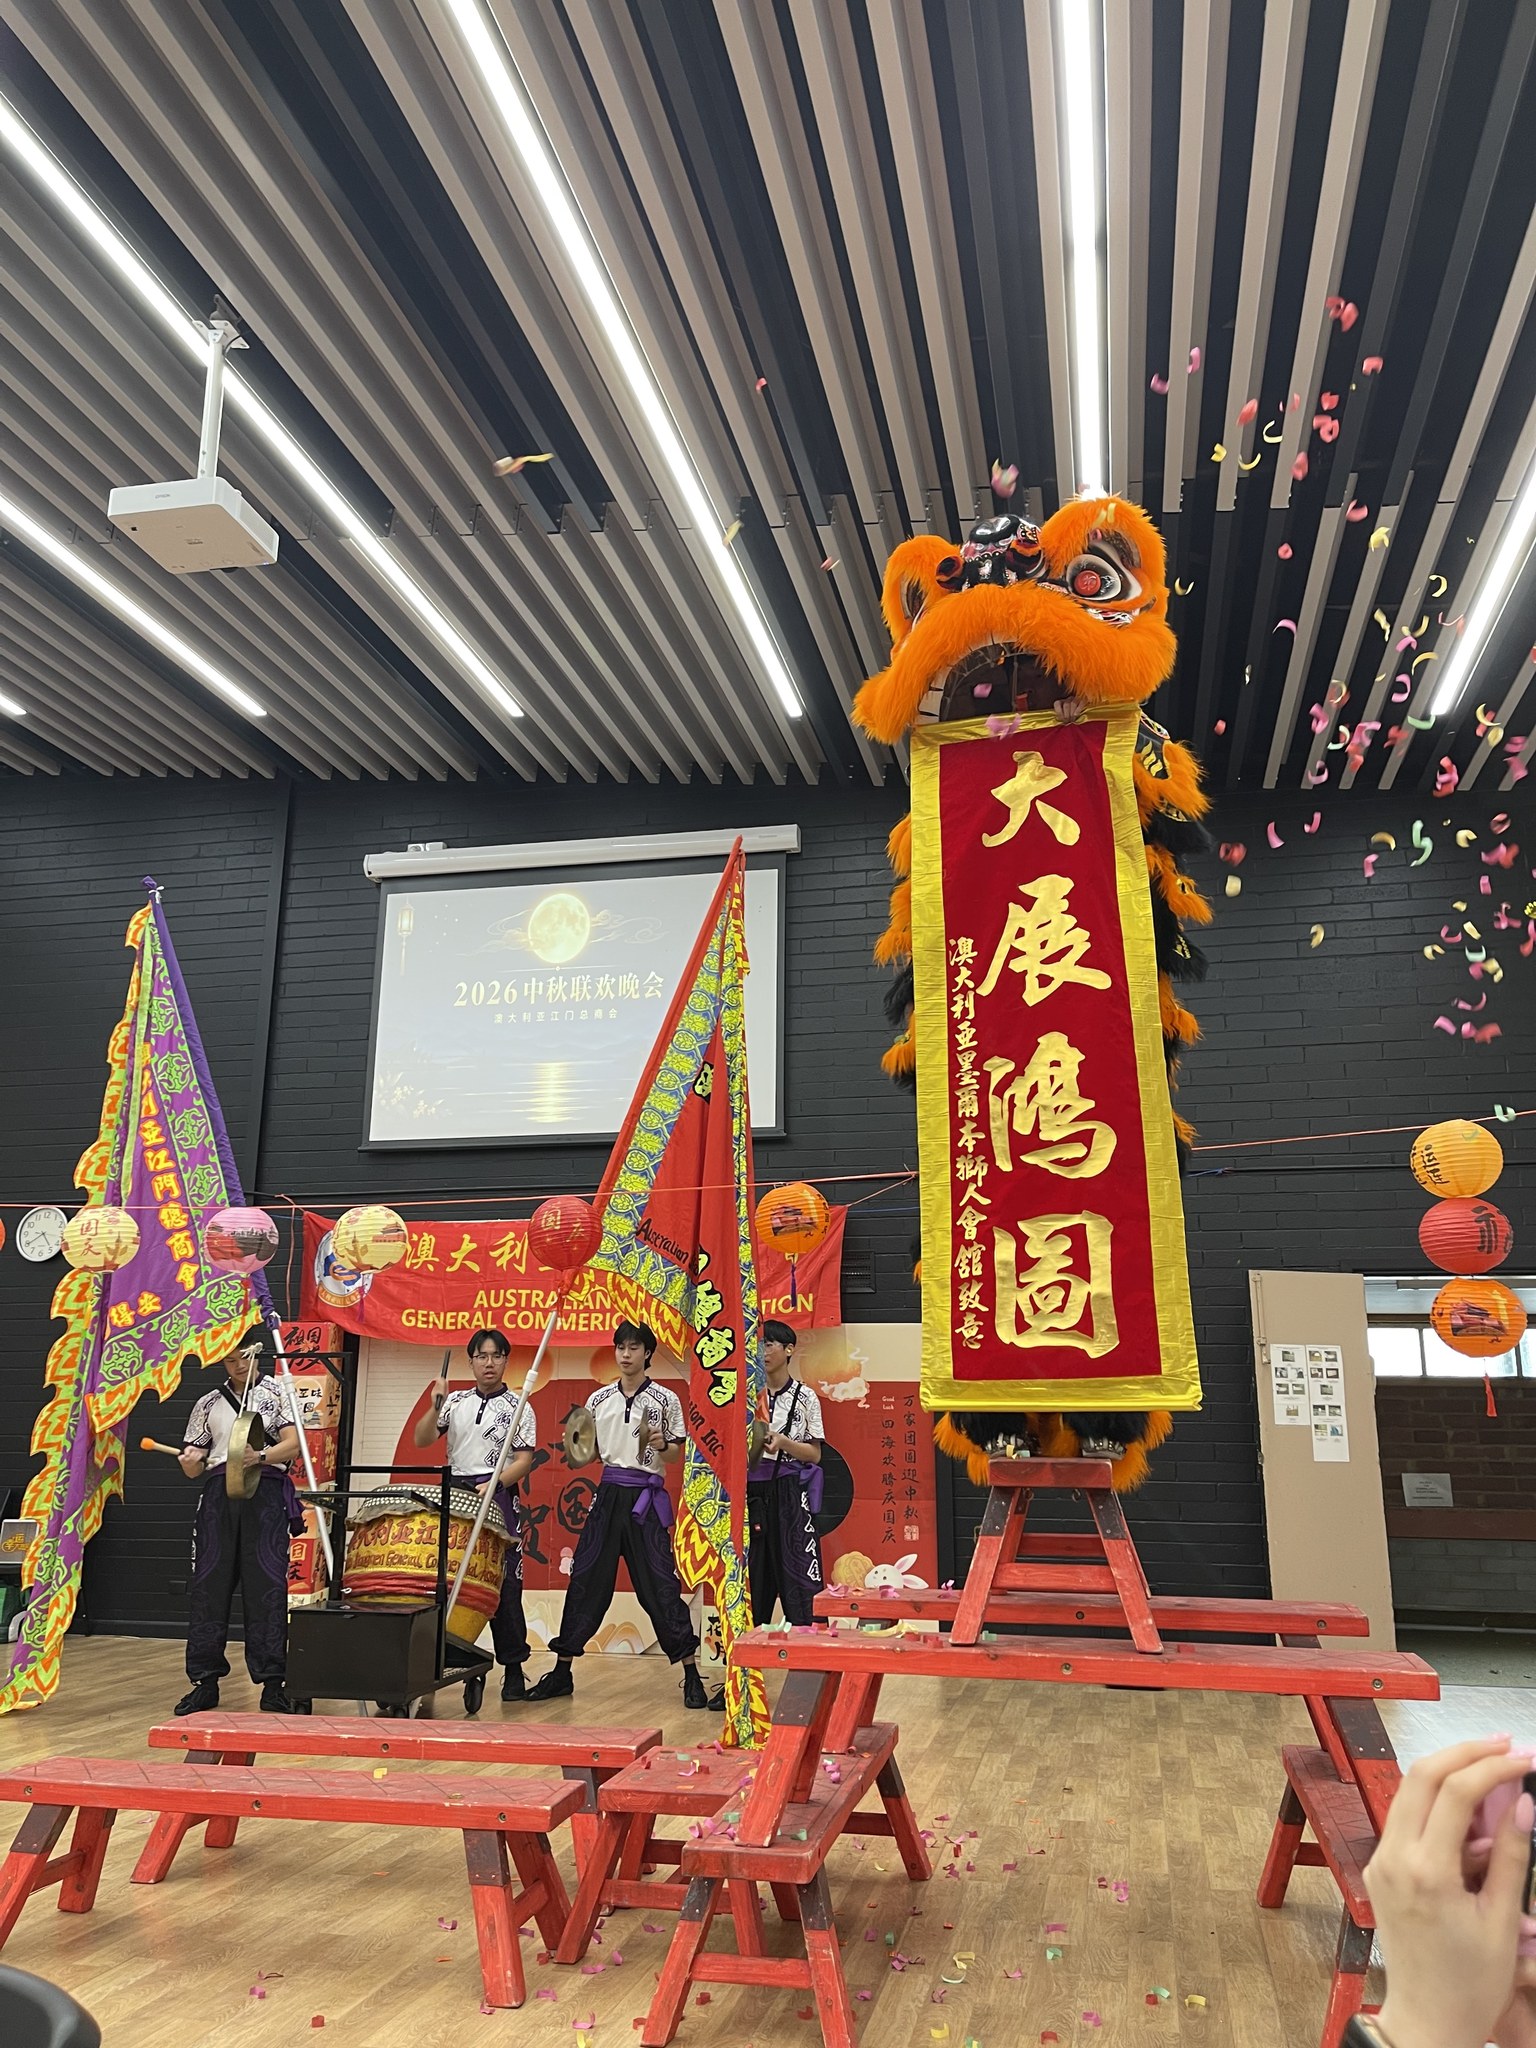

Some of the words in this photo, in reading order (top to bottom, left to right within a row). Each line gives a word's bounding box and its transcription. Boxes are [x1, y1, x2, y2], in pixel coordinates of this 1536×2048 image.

[493, 1008, 618, 1024] 澳大利亚江门总商会
[976, 750, 1120, 1359] 大展鴻圖
[27, 1221, 35, 1229] 10
[43, 1211, 51, 1219] 12
[48, 1246, 53, 1254] 5
[80, 1218, 101, 1257] 国庆
[38, 1249, 44, 1257] 6
[405, 1231, 554, 1275] 澳大利
[401, 1308, 498, 1330] GENERAL
[503, 1310, 624, 1332] COMMERIC
[761, 1293, 814, 1315] TION
[700, 1428, 724, 1457] Inc
[901, 1394, 920, 1519] 万家团圆迎中秋
